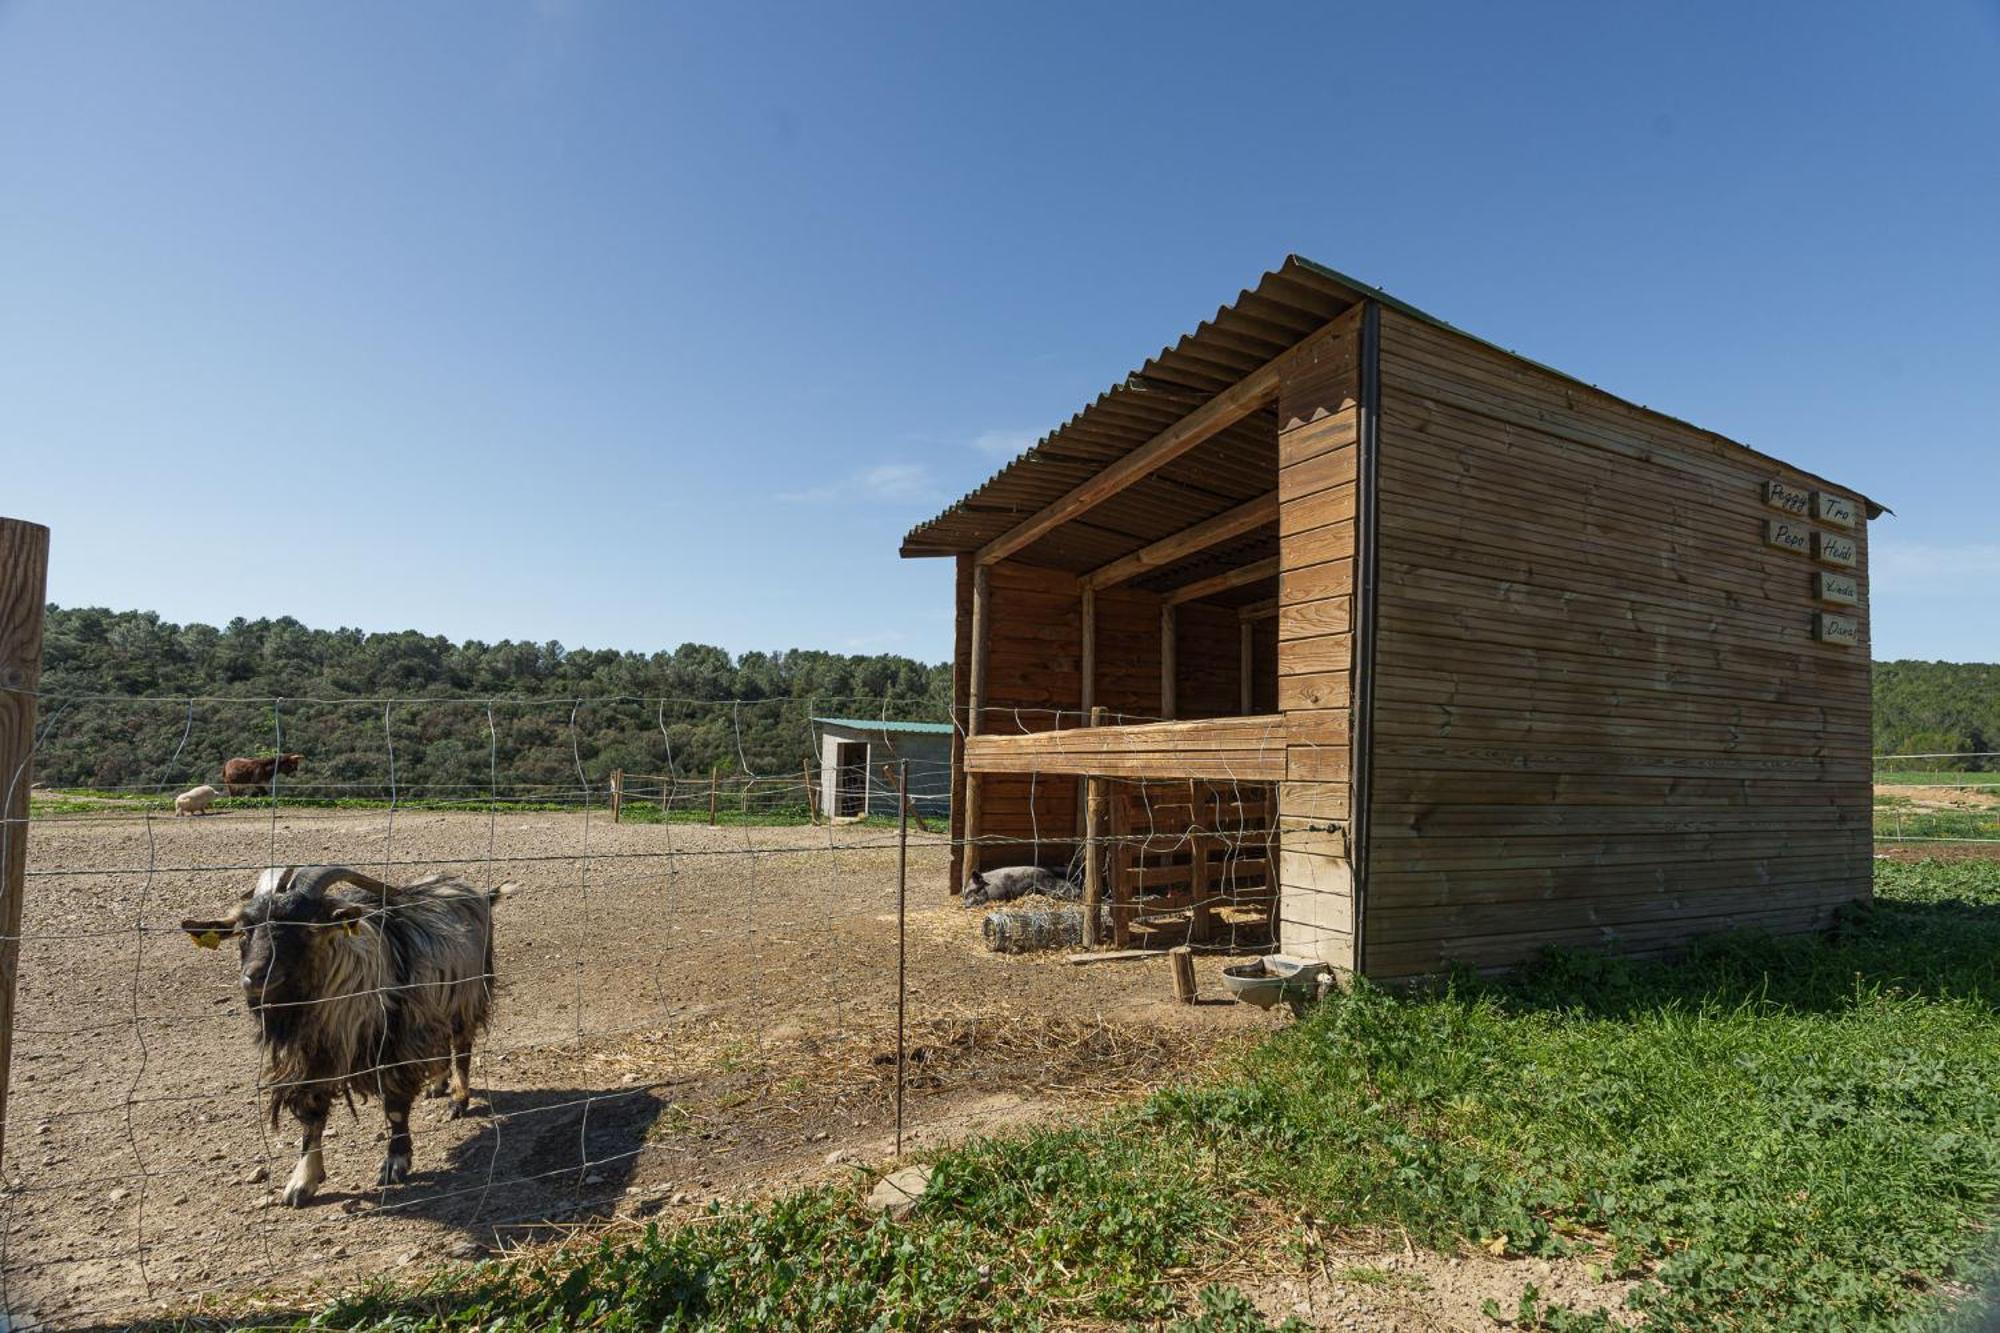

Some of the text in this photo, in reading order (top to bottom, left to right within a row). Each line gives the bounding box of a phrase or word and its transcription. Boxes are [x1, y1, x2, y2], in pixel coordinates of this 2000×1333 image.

[1771, 484, 1808, 512] Peggy
[1825, 499, 1849, 520] Tro
[1775, 525, 1805, 547] Pepo
[1824, 538, 1852, 561] Heidi
